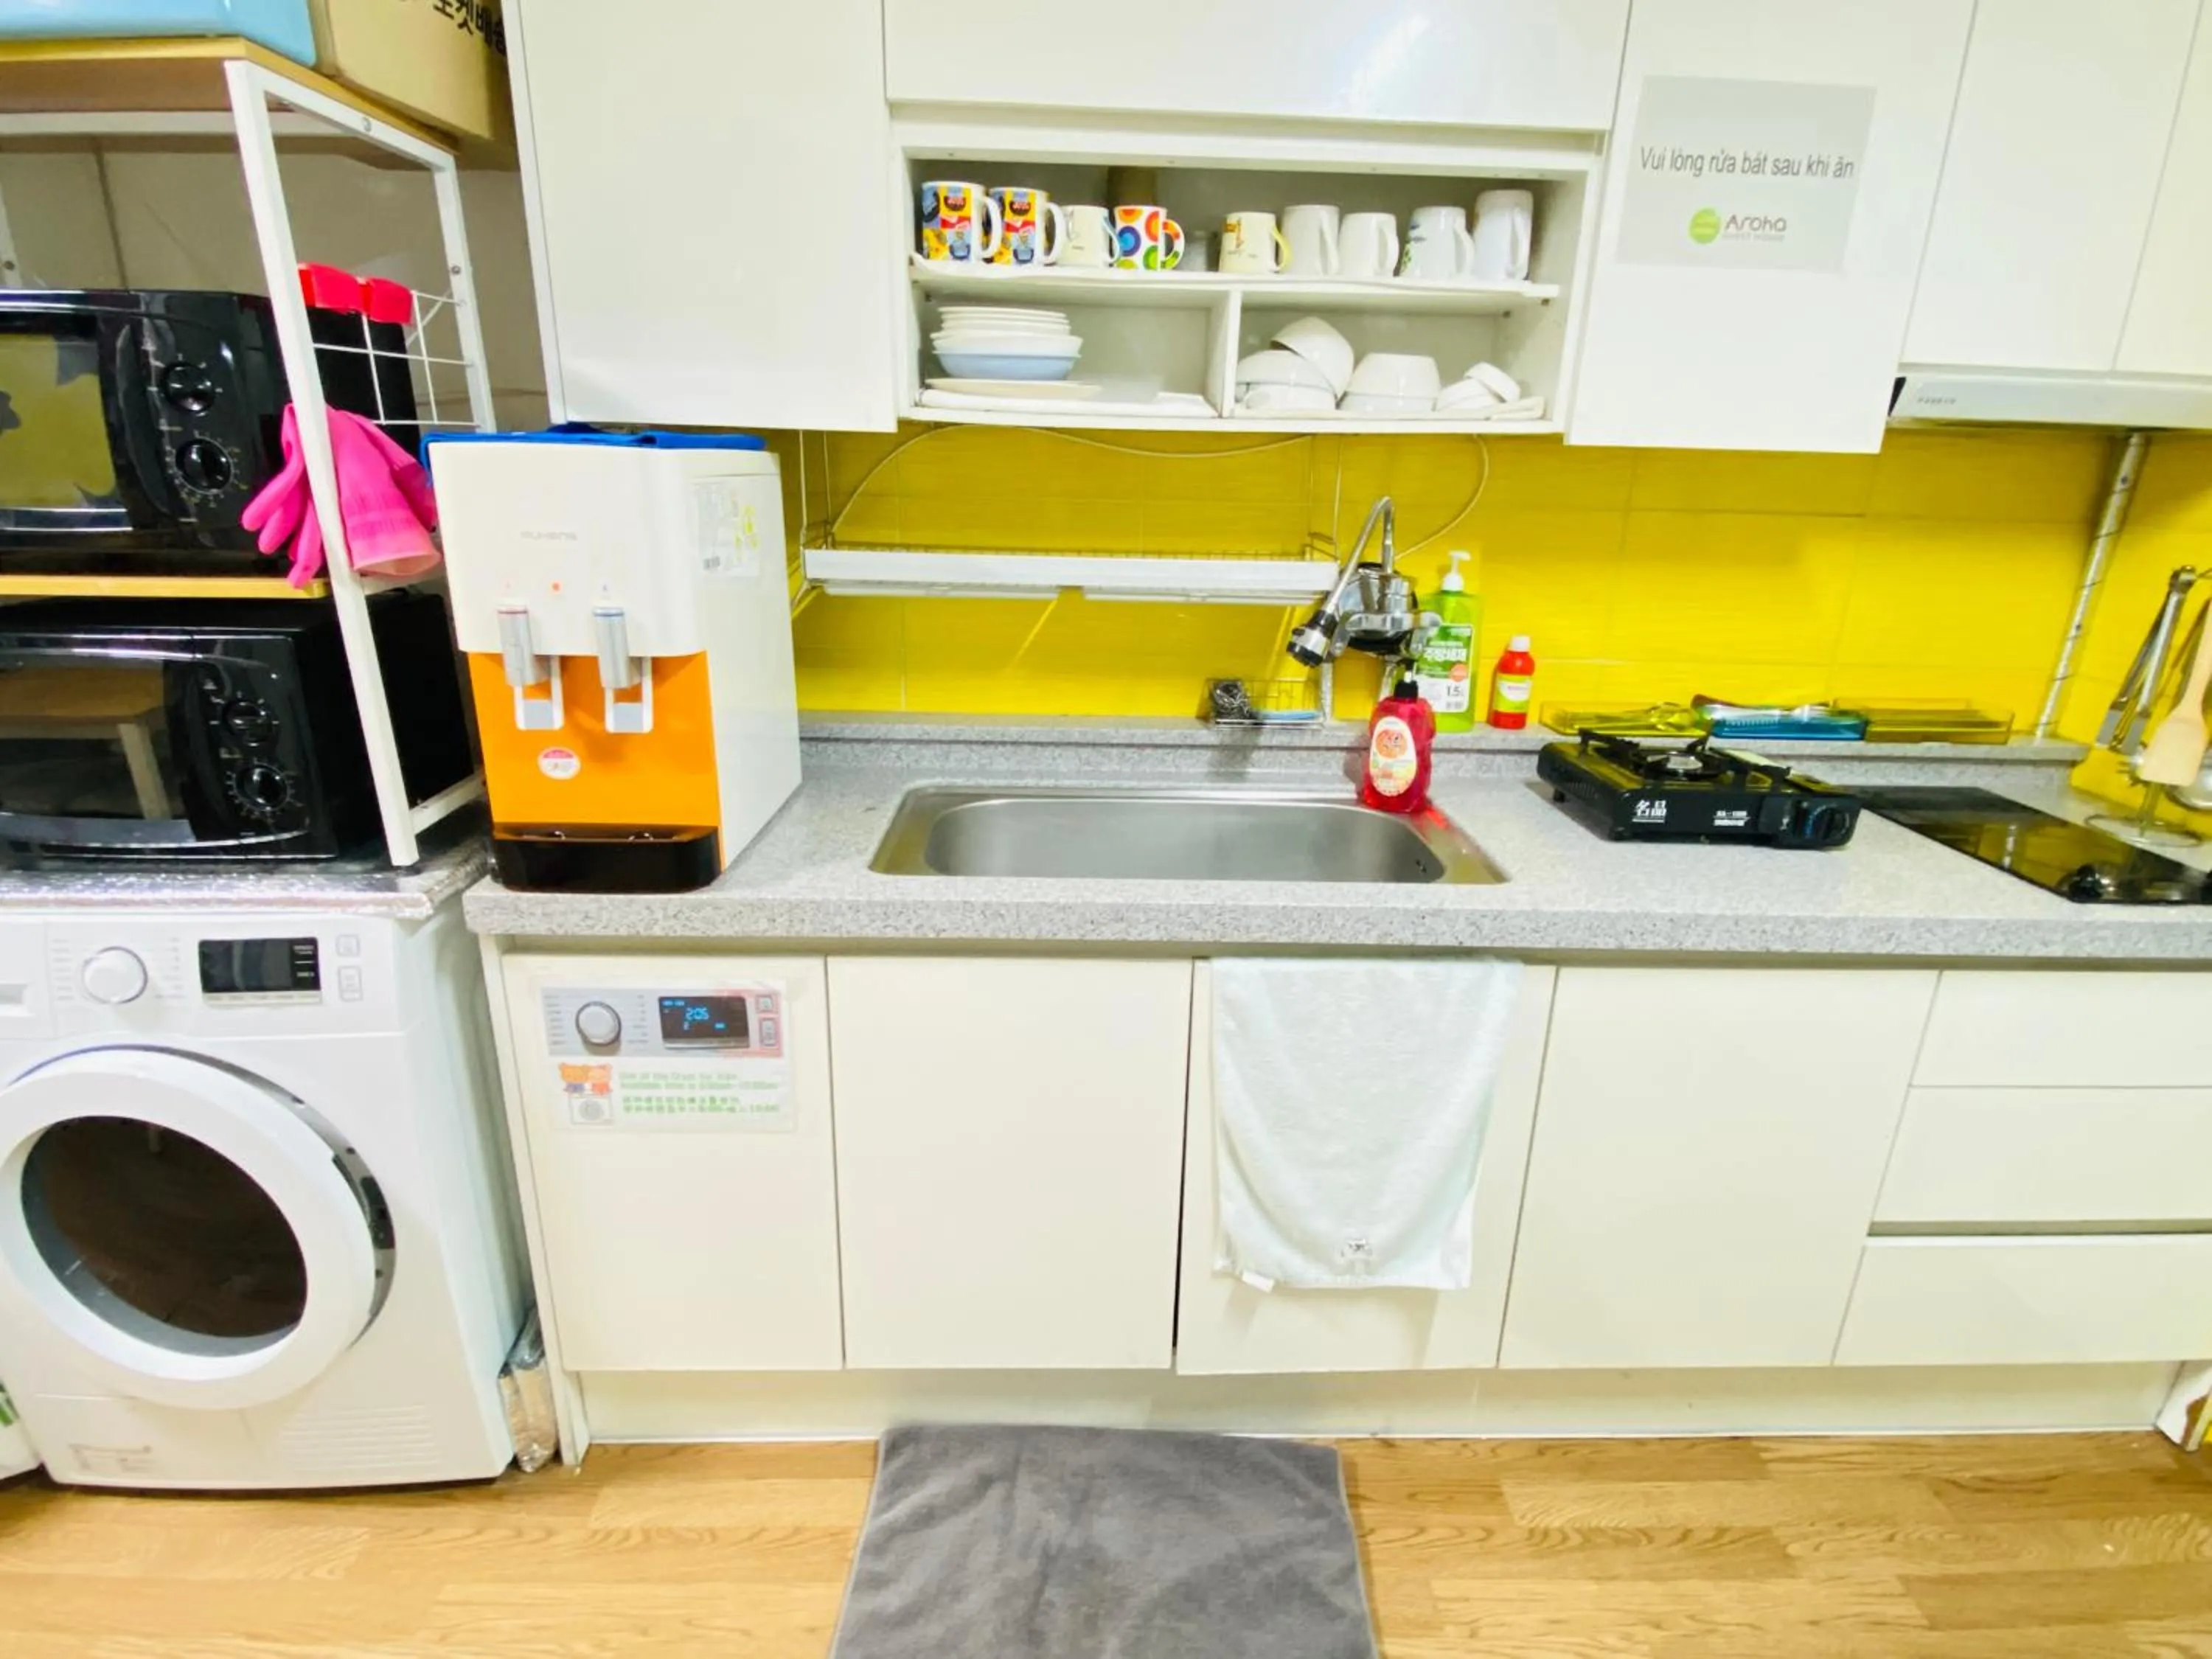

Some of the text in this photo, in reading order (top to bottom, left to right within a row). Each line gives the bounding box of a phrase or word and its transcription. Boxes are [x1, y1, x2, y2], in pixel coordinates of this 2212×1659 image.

[1641, 147, 1666, 170] Vui
[1741, 150, 1768, 175] bát
[1771, 157, 1802, 176] sau
[1806, 153, 1830, 178] khi
